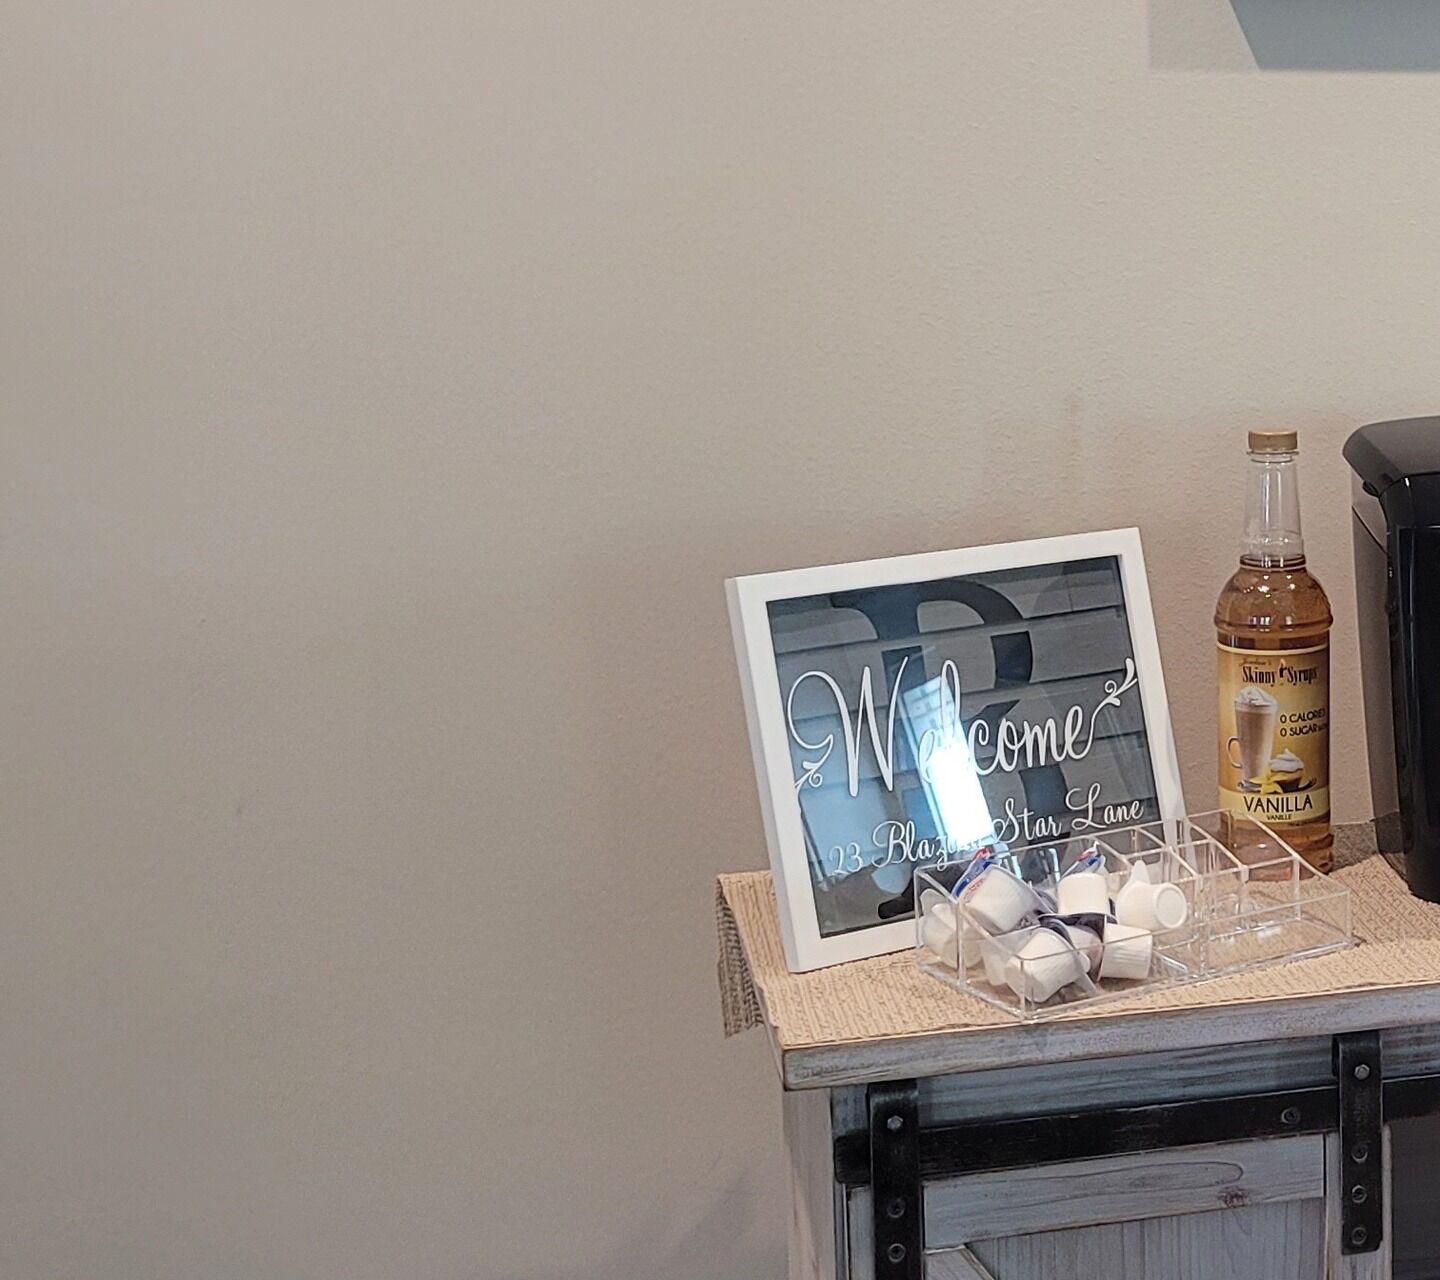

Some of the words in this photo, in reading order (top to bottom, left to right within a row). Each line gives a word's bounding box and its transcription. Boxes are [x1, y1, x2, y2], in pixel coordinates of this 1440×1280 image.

[1242, 665, 1278, 687] Skinny
[1286, 665, 1318, 685] Syrups
[1243, 794, 1313, 813] VANILLA
[828, 842, 863, 874] 23
[992, 798, 1063, 844] Star
[1065, 782, 1144, 831] Lane
